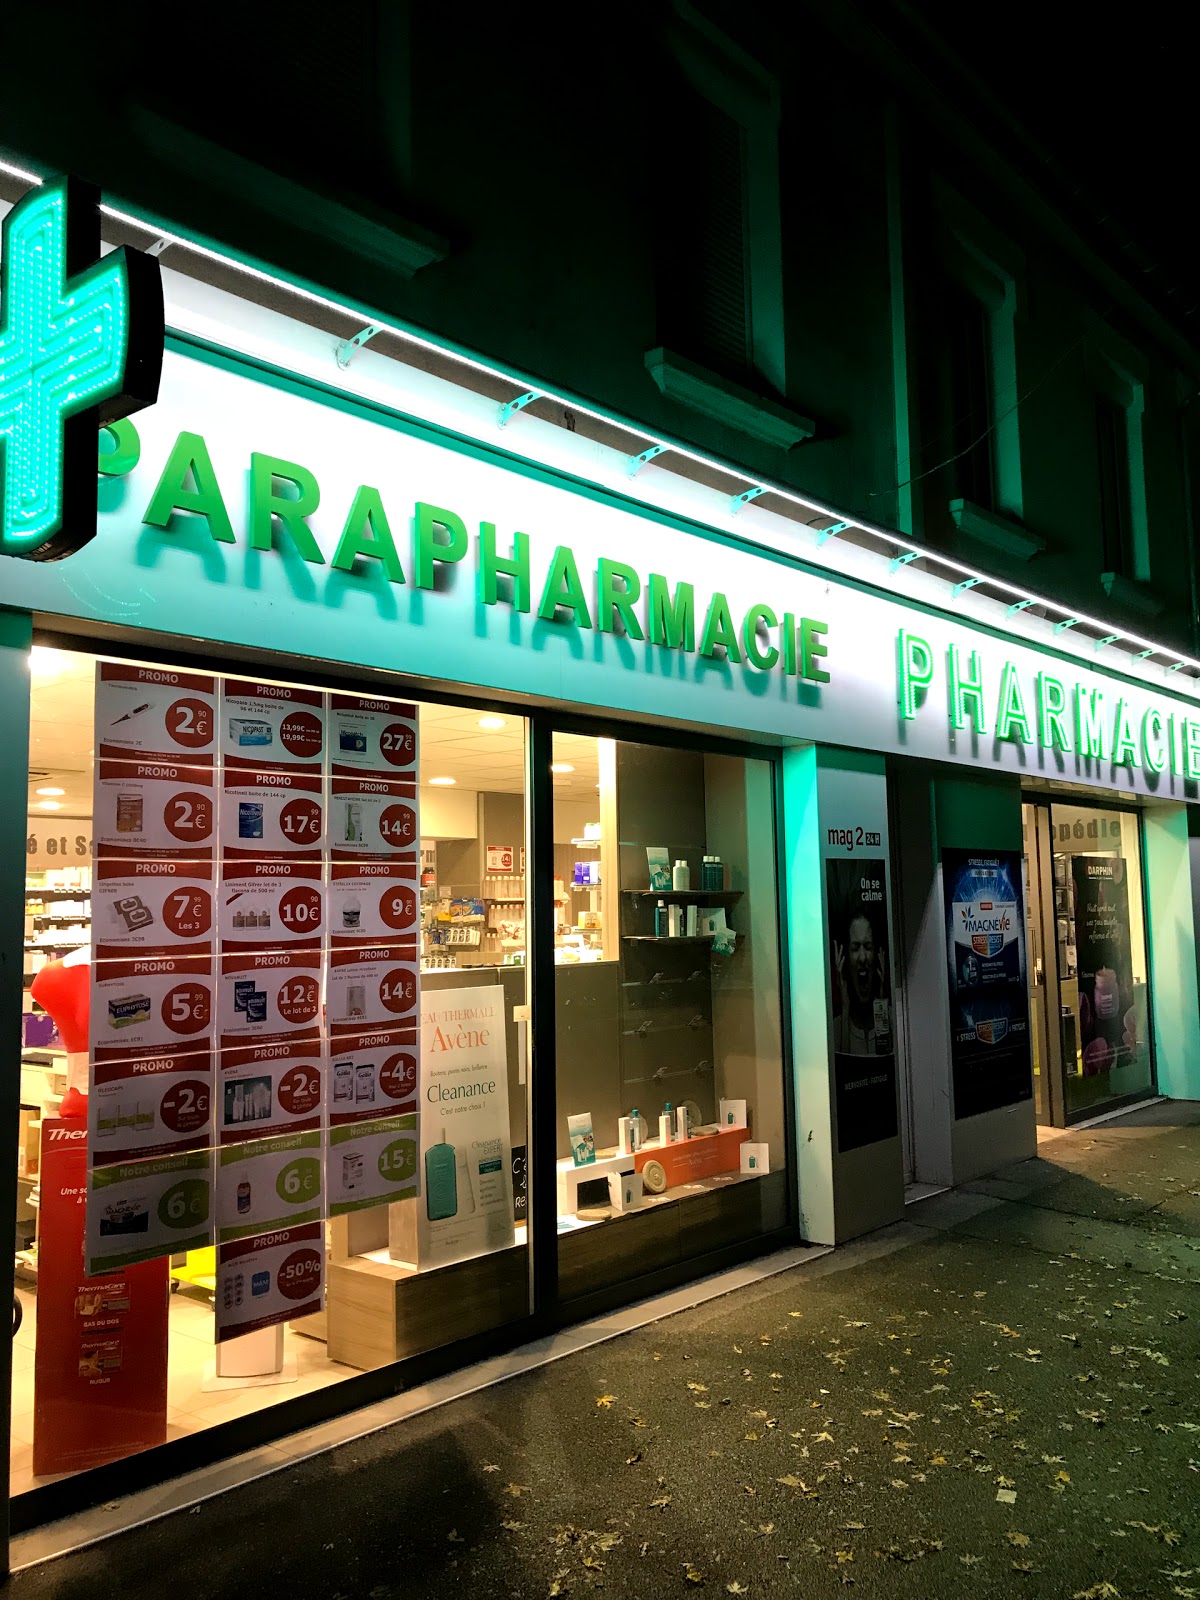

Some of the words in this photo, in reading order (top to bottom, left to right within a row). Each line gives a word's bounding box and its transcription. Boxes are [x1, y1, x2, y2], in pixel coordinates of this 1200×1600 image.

[138, 670, 179, 683] PROMO
[256, 685, 292, 698] PROMO
[359, 700, 390, 711] PROMO
[898, 628, 1200, 780] PHARMACIE
[198, 710, 207, 718] 90
[282, 733, 305, 742] 19,99€
[137, 766, 178, 778] PROMO
[256, 775, 292, 786] PROMO
[359, 782, 389, 792] PROMO
[46, 836, 67, 856] et
[135, 864, 176, 874] PROMO
[255, 865, 291, 874] PROMO
[359, 866, 390, 874] PROMO
[1088, 866, 1113, 876] DARPHIN
[861, 878, 871, 889] On
[872, 879, 880, 889] se
[861, 890, 883, 902] calme
[178, 922, 193, 930] Les
[255, 956, 290, 966] PROMO
[359, 950, 390, 960] PROMO
[134, 961, 175, 972] PROMO
[116, 1002, 150, 1014] EUPHYTOSE
[441, 1006, 496, 1022] THERMALE
[359, 1035, 390, 1047] PROMO
[430, 1024, 490, 1053] Avène
[961, 1032, 976, 1042] STRESS
[254, 1046, 290, 1059] PROMO
[132, 1060, 174, 1073] PROMO
[427, 1080, 496, 1103] Cleanance
[440, 1107, 454, 1116] C'est
[454, 1104, 468, 1113] notre
[350, 1127, 373, 1136] Notre
[373, 1120, 400, 1131] conseil
[243, 1145, 268, 1155] Notre
[270, 1137, 302, 1150] conseil
[120, 1165, 150, 1177] Notre
[153, 1158, 188, 1172] conseil
[61, 1188, 77, 1196] Une
[253, 1232, 290, 1248] PROMO
[280, 1260, 321, 1279] -50%
